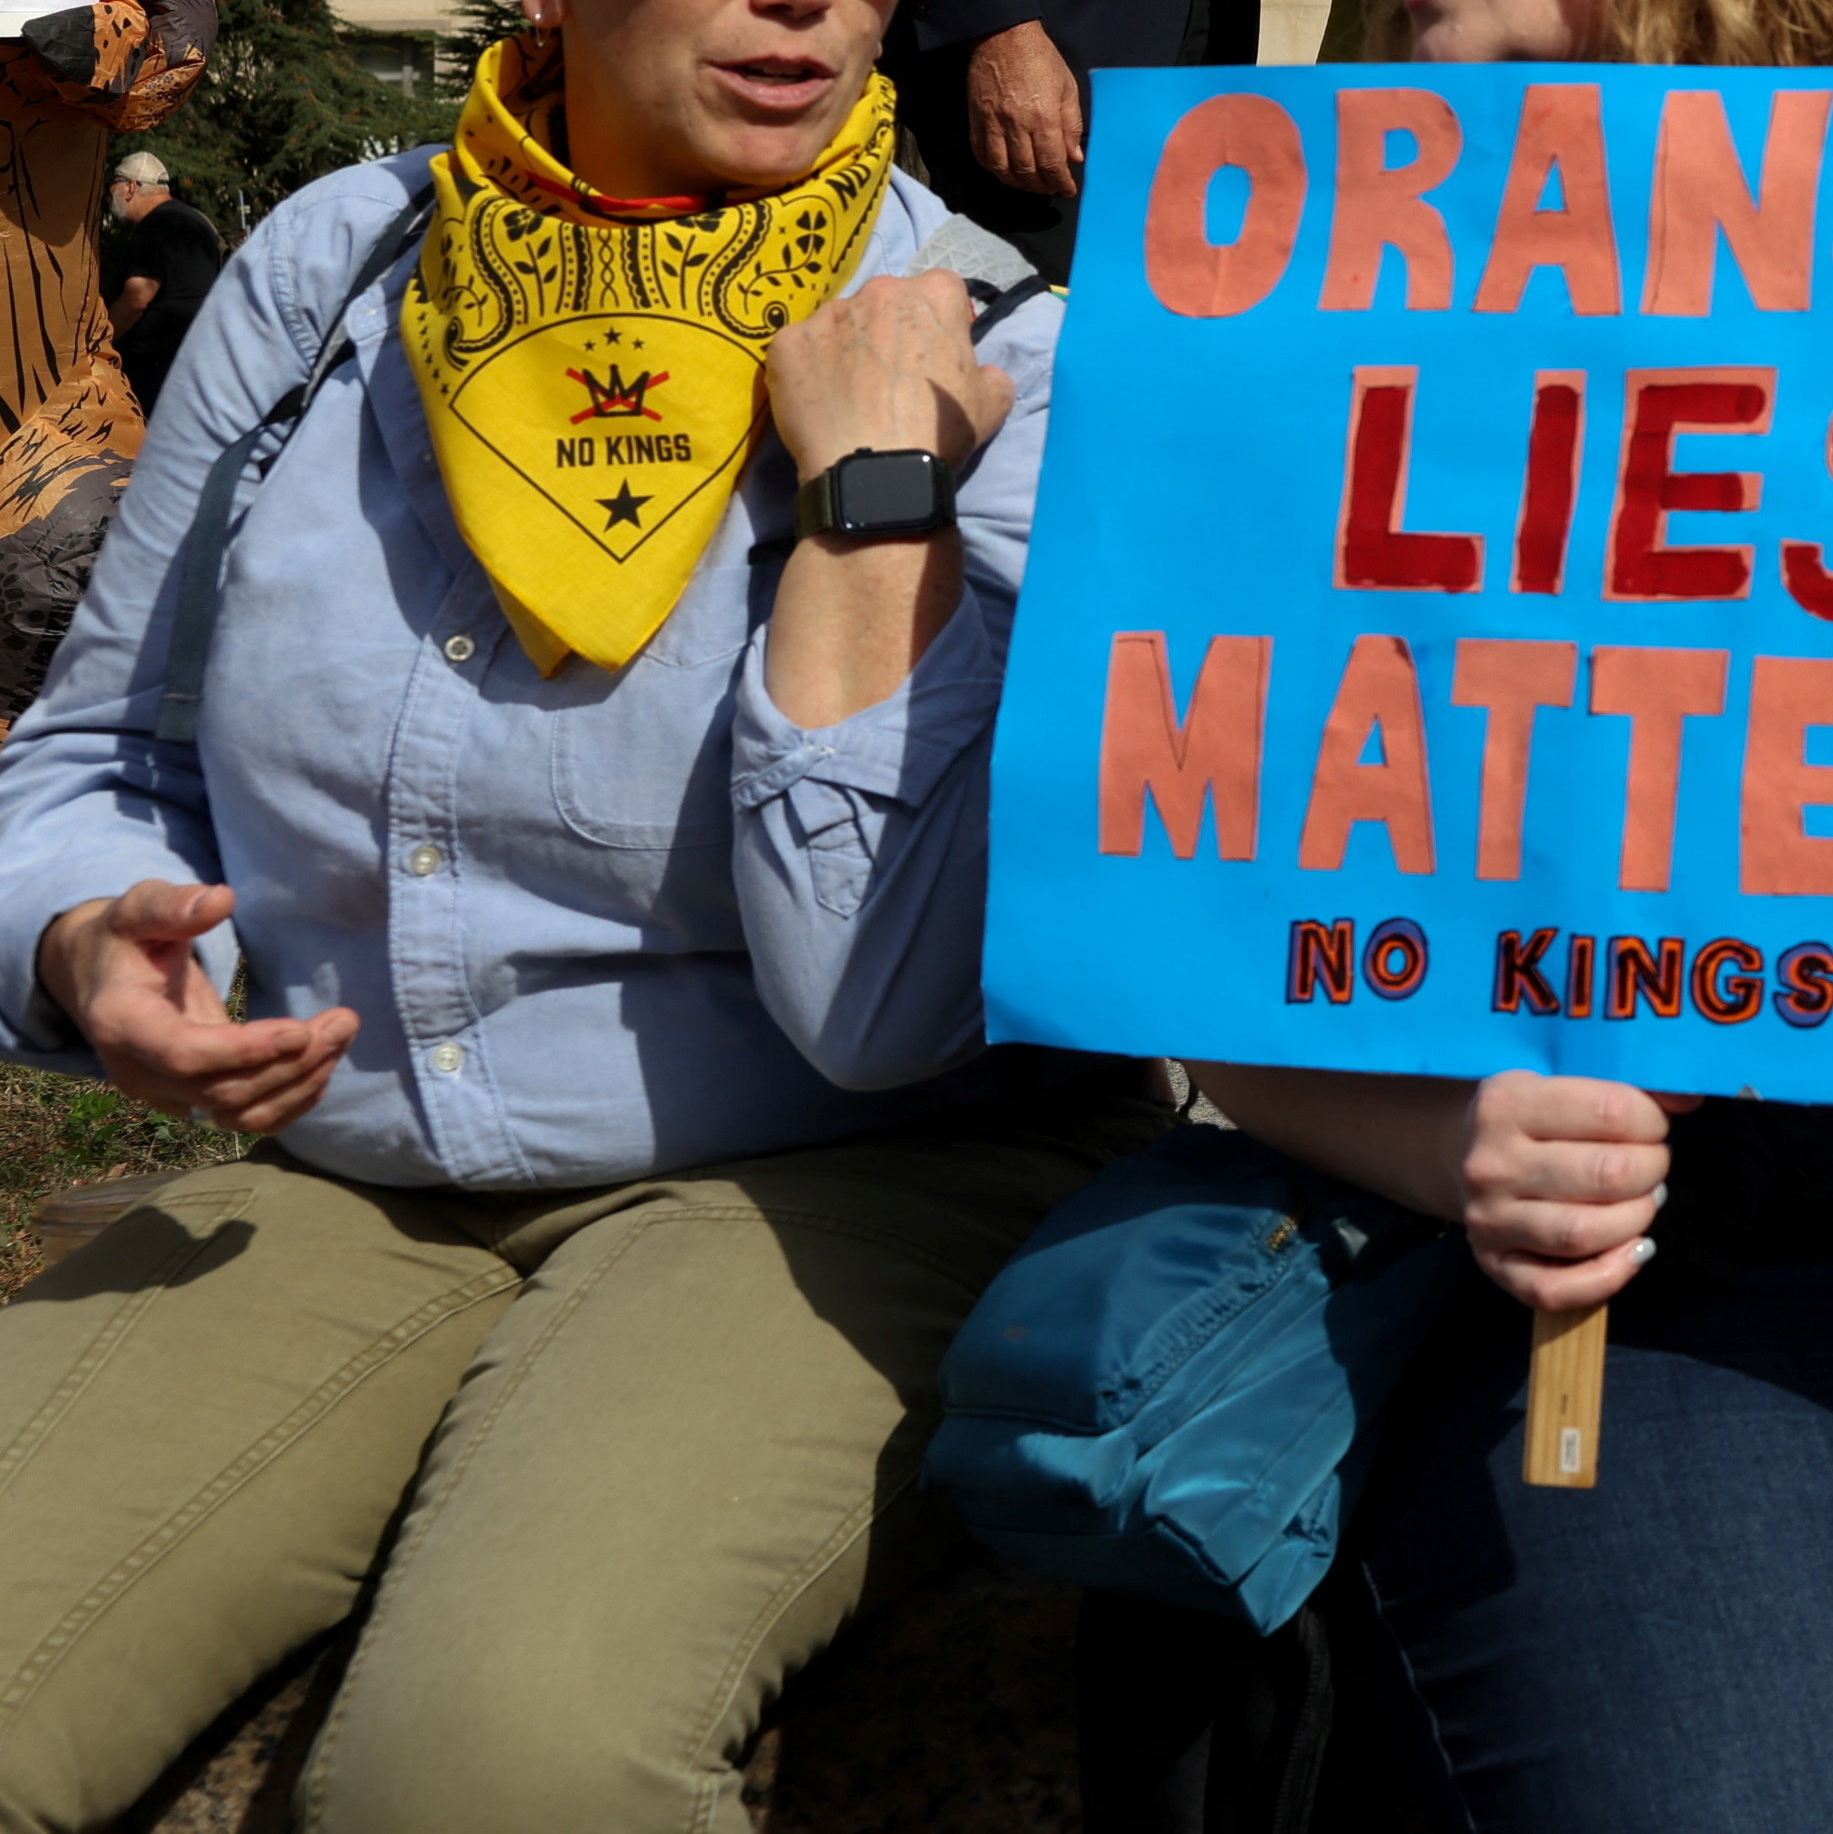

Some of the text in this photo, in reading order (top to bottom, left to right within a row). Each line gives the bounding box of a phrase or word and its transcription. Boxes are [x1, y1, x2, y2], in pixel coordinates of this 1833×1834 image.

[556, 432, 692, 469] NO KINGS
[1286, 917, 1429, 1005] NO
